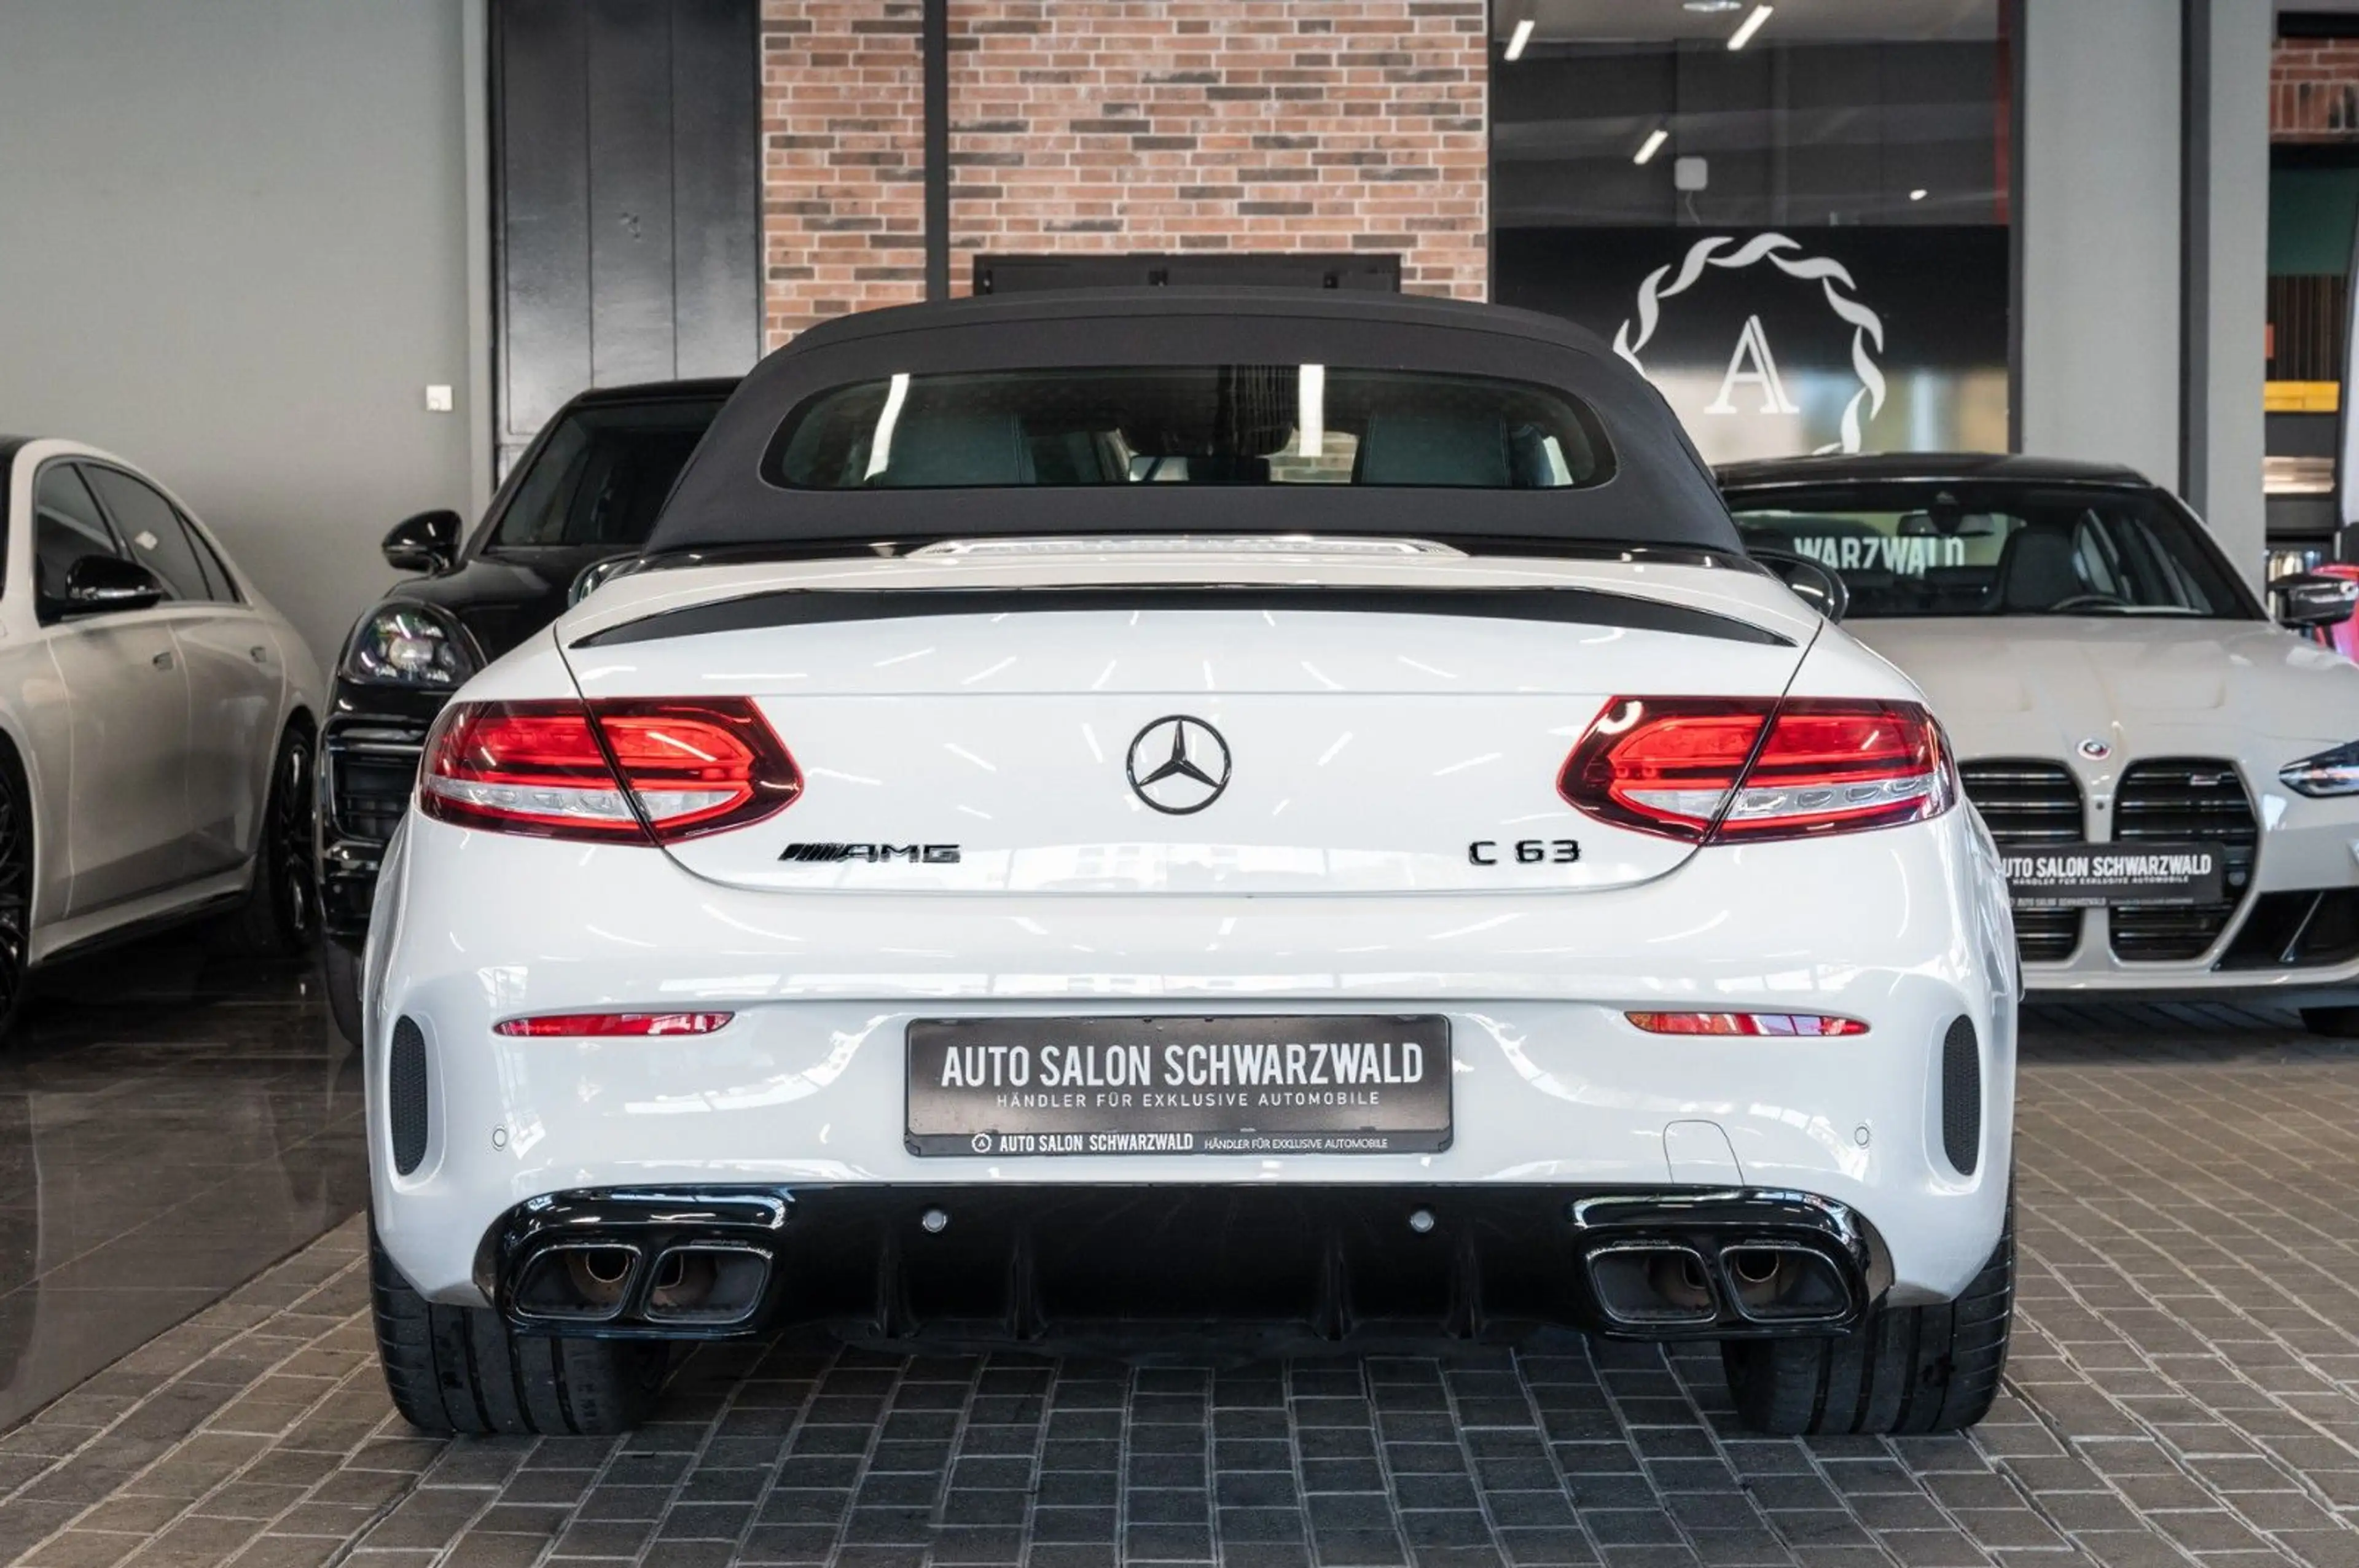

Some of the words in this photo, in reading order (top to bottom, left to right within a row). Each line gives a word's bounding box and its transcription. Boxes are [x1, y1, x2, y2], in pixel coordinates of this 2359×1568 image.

[1703, 314, 1800, 415] A
[839, 843, 961, 864] AMG
[1468, 840, 1498, 866] C
[1514, 838, 1581, 864] 63
[2003, 857, 2033, 878] UTO
[2035, 856, 2089, 878] SALON
[2092, 854, 2212, 876] SCHWARZWALD
[941, 1045, 1030, 1087] AUTO
[1039, 1045, 1151, 1087] SALON
[1164, 1042, 1424, 1086] SCHWARZWALD
[997, 1091, 1086, 1108] HÄNDLER
[1096, 1091, 1132, 1107] FÜR
[1142, 1092, 1248, 1107] EXKLUSIVE
[1258, 1091, 1380, 1106] AUTOMOBILE
[999, 1135, 1035, 1152] AUTO
[1039, 1134, 1083, 1152] SALON
[1089, 1133, 1194, 1151] SCHWARZWALD
[1204, 1136, 1250, 1150] HÄNDLER
[1251, 1136, 1270, 1150] FÜR
[1272, 1138, 1323, 1150] EXKLUSIVE
[1324, 1137, 1388, 1149] AUTOMOBILE
